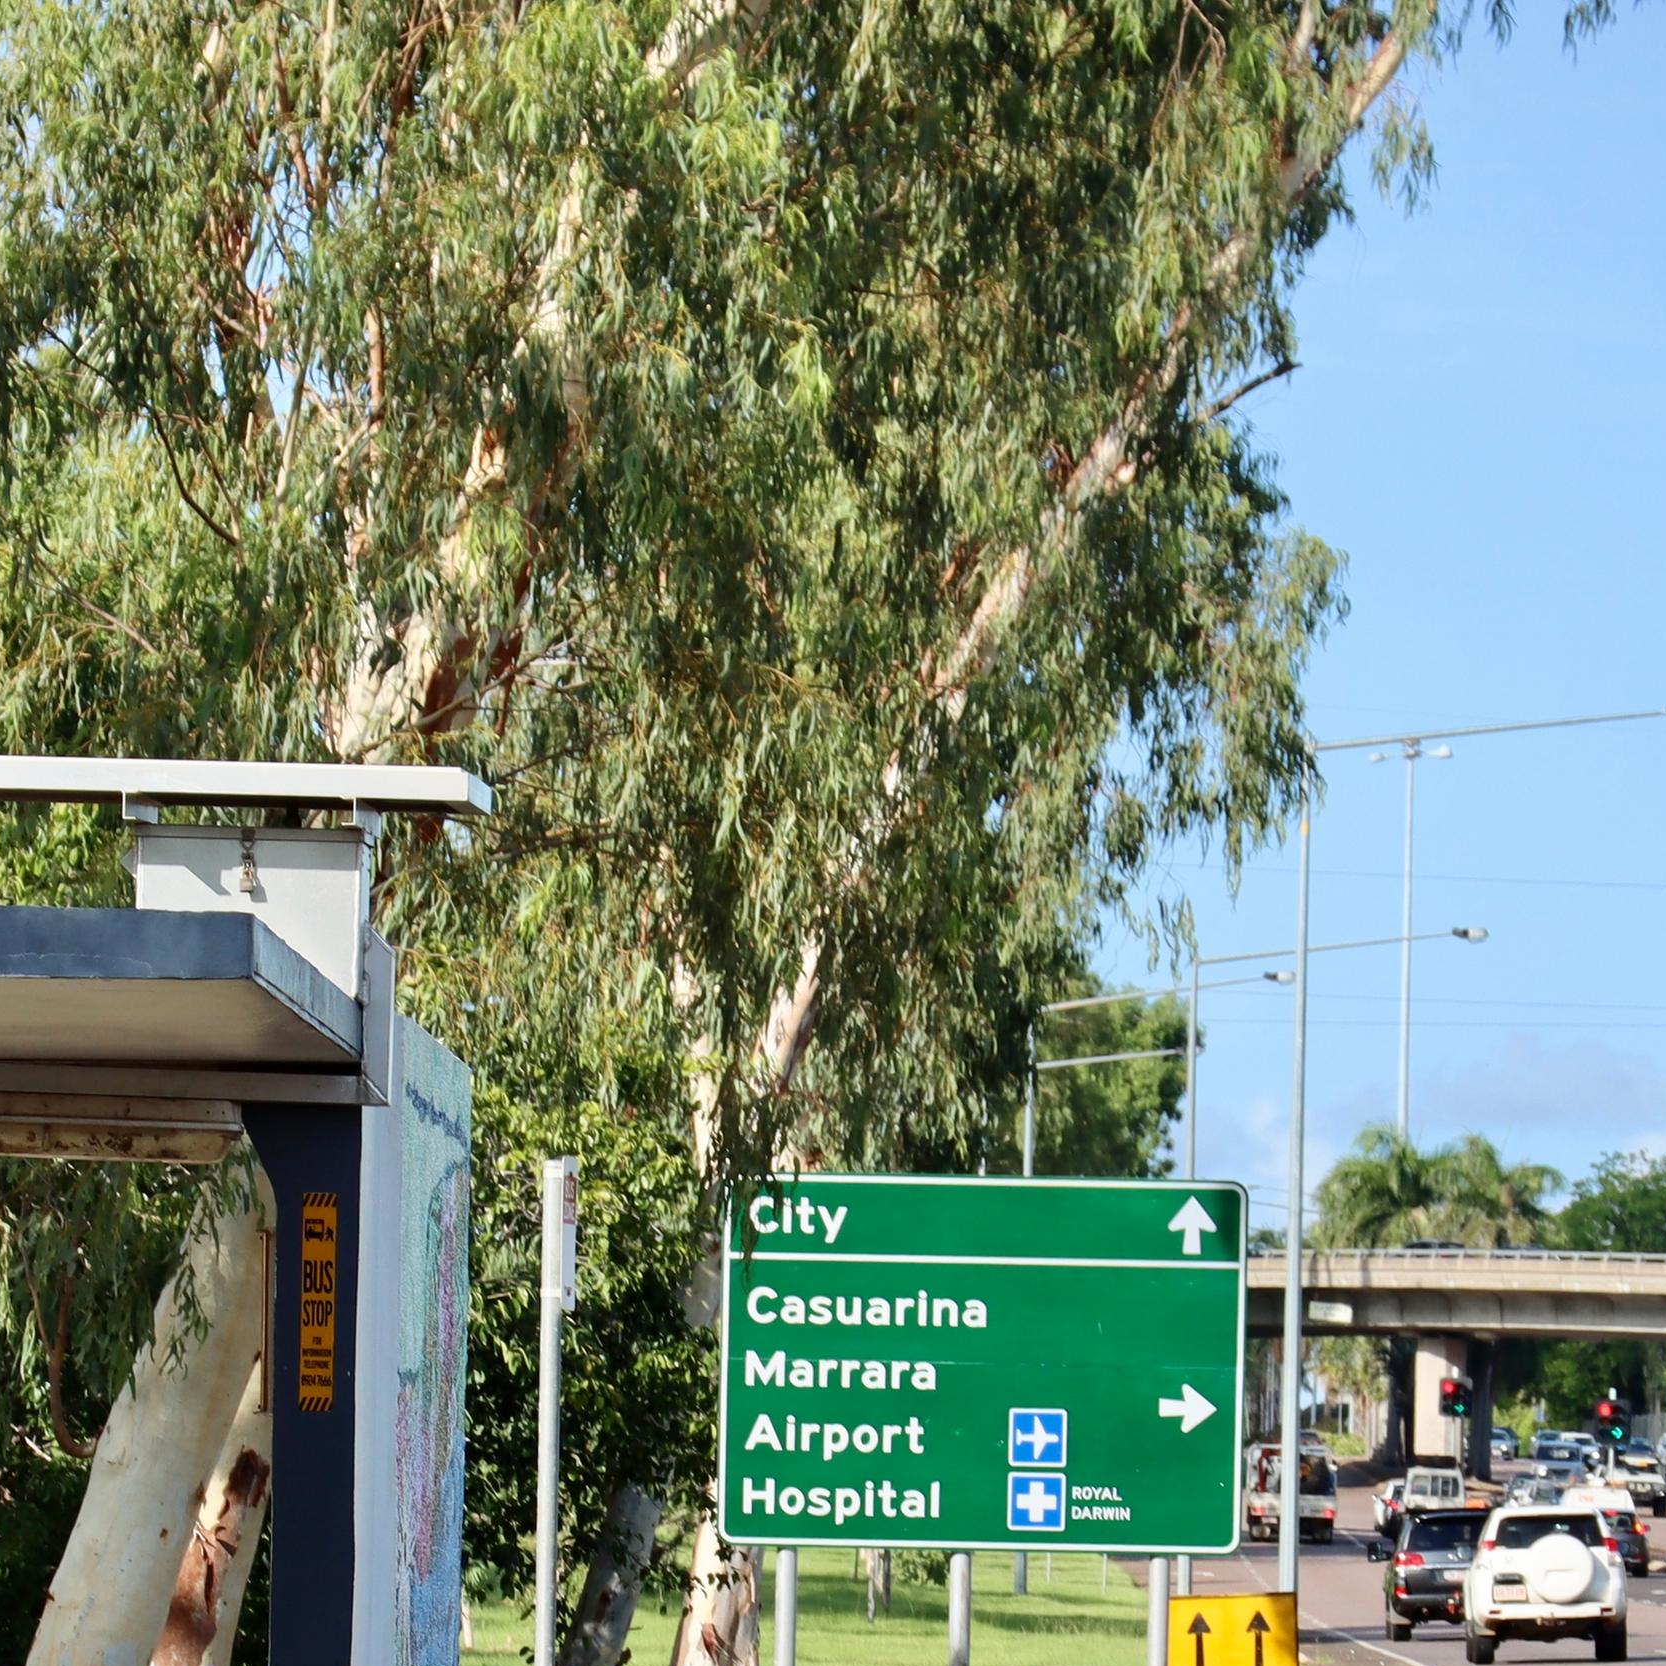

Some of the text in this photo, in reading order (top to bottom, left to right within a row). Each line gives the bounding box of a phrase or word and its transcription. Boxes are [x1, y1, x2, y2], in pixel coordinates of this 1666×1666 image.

[749, 1196, 848, 1244] City
[303, 1260, 334, 1293] BUS
[302, 1300, 333, 1327] STOP
[746, 1286, 987, 1328] Casuarina
[745, 1350, 937, 1391] Marrara
[744, 1413, 925, 1461] Airport
[742, 1477, 941, 1525] Hospital
[1071, 1486, 1123, 1501] ROYAL
[1071, 1506, 1131, 1521] DARWIN
